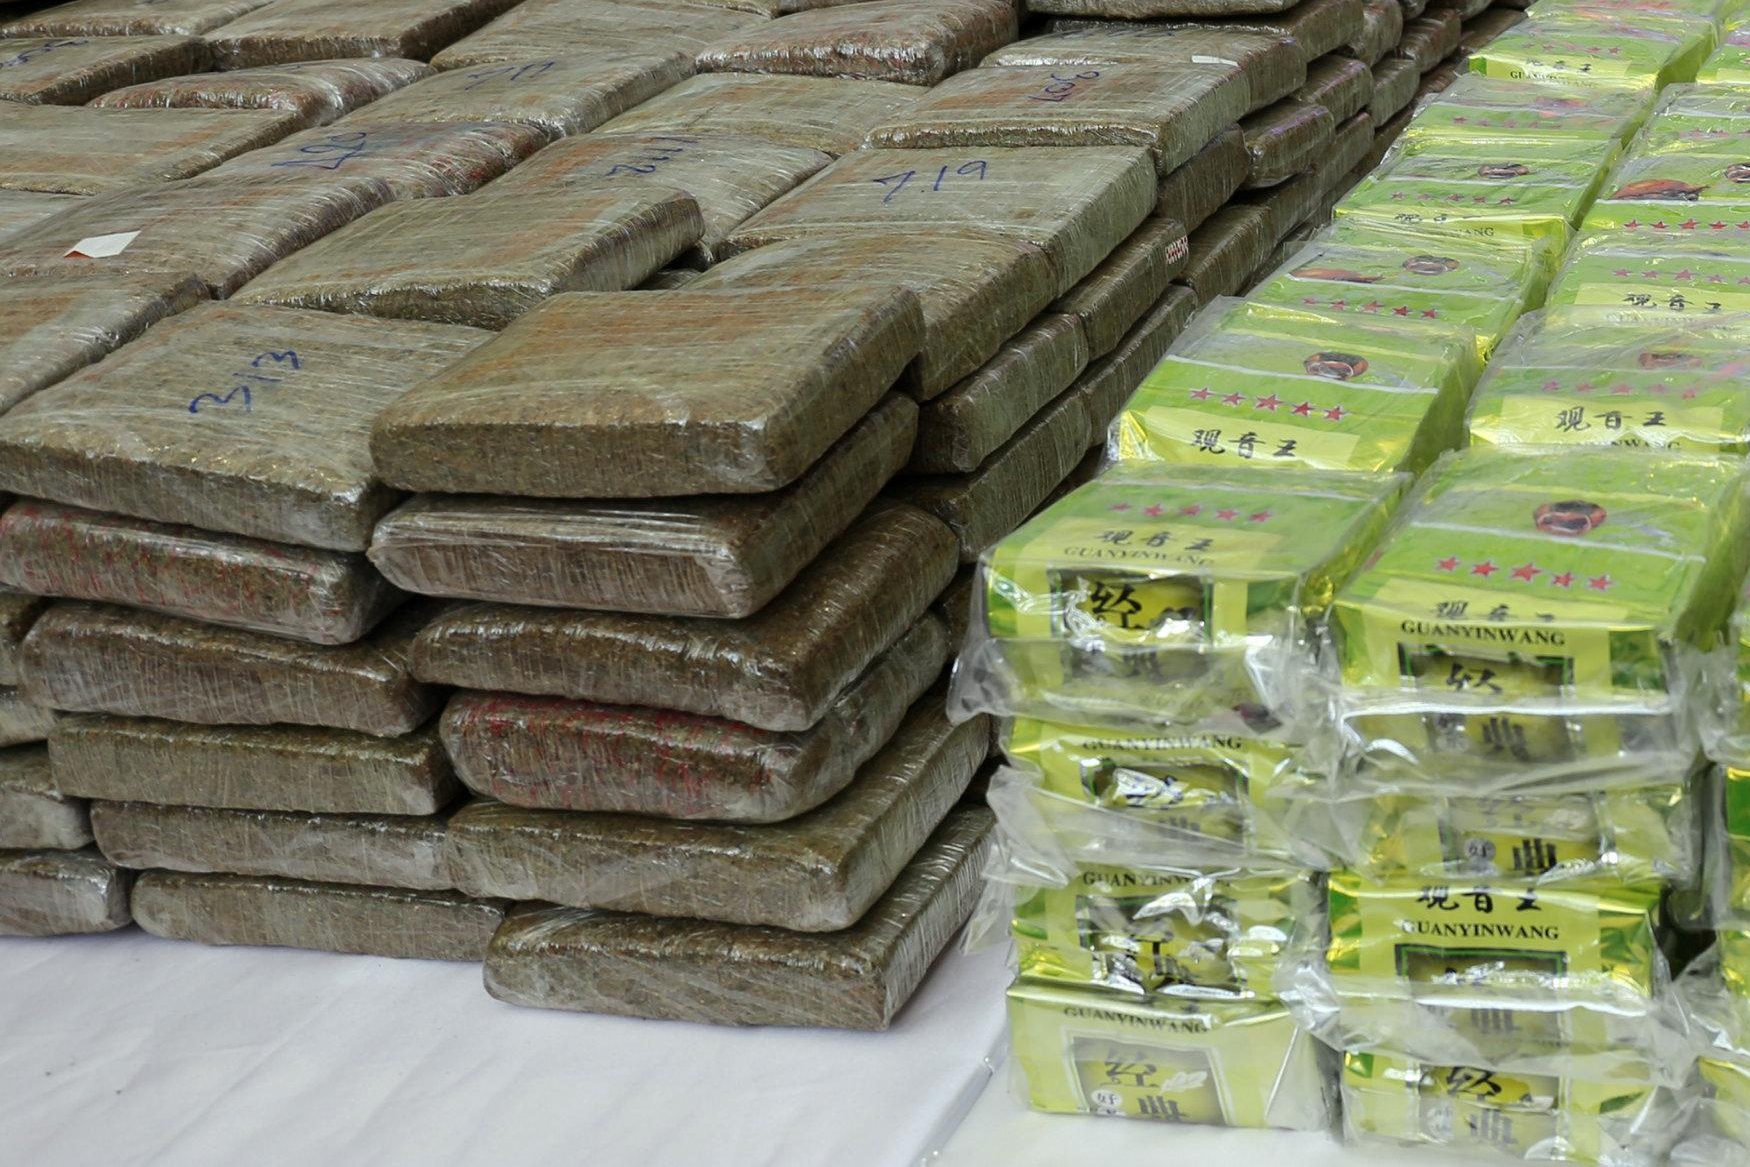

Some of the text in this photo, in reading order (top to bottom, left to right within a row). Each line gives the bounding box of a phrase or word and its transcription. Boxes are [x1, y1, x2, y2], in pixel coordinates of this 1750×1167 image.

[1555, 406, 1667, 432] 观音王
[1190, 428, 1299, 460] 观音王
[1099, 529, 1215, 553] 观音王
[1063, 545, 1215, 566] GUANYINWANG
[1400, 618, 1566, 647] GUANYINWANG
[1063, 1006, 1209, 1034] GUANYINWANG
